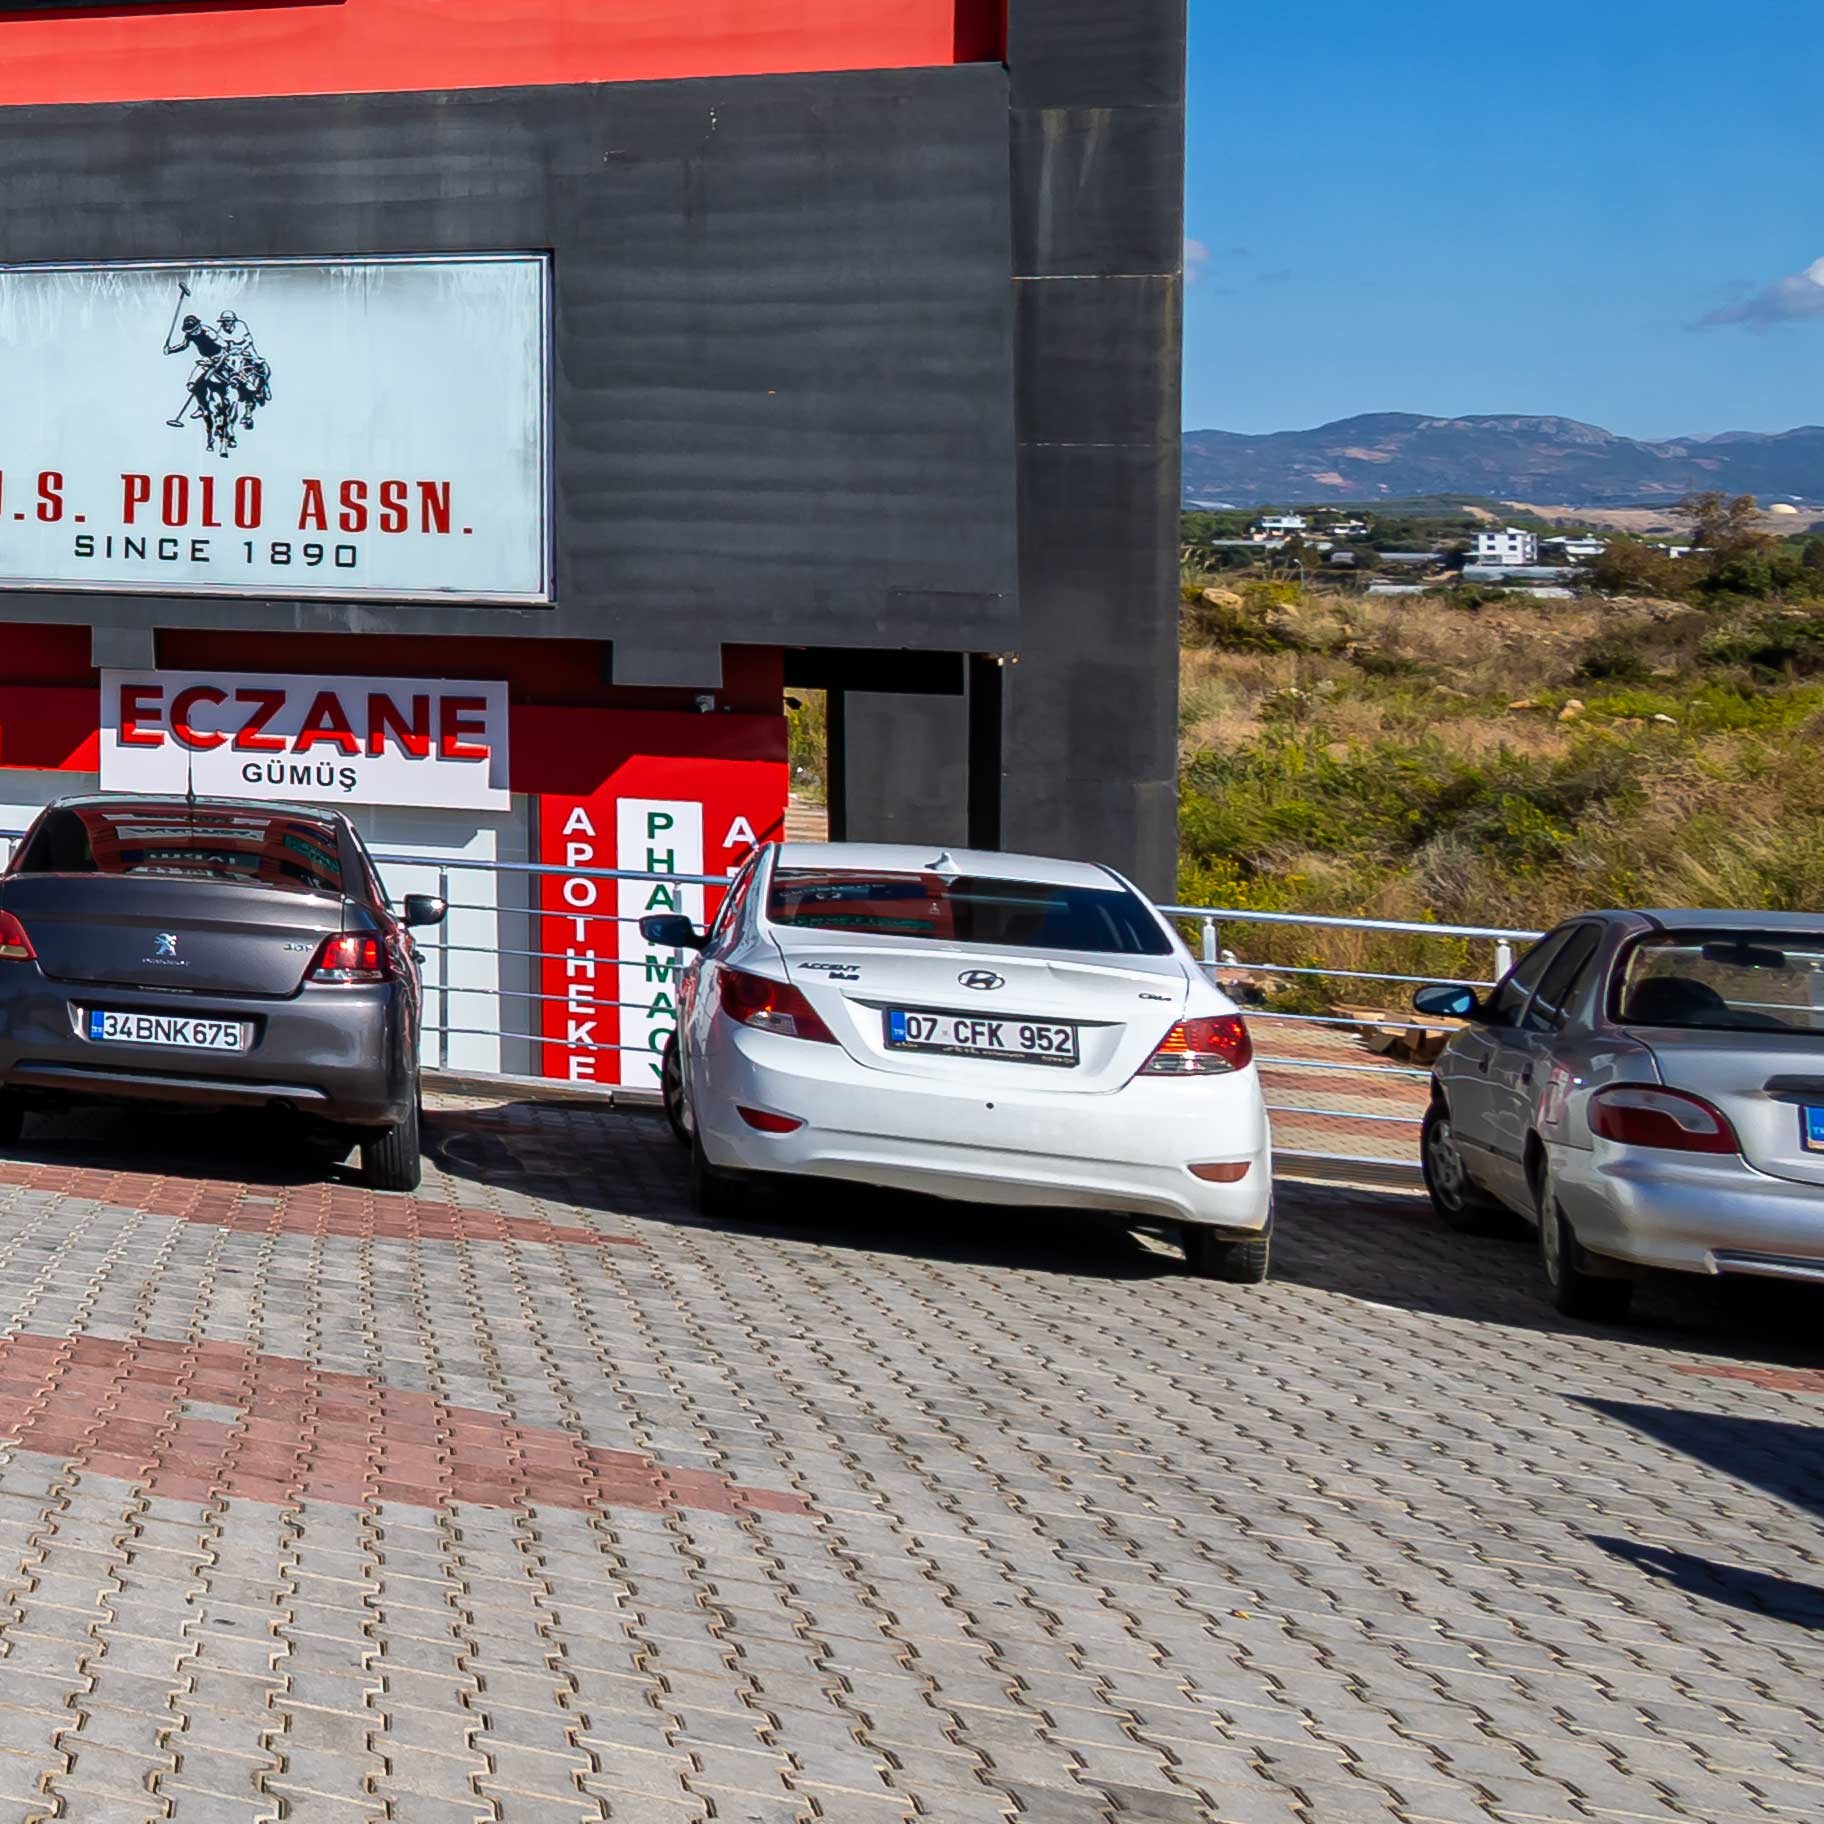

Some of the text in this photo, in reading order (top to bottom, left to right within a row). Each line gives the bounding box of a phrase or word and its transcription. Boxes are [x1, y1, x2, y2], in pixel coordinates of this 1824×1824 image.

[120, 473, 263, 529] POLO
[298, 478, 474, 536] ASSN.
[73, 533, 358, 569] SINCE 1890
[117, 685, 492, 761] ECZANE
[240, 760, 359, 793] GÜMÜŞ
[562, 806, 597, 1085] APOTHEKE
[905, 1015, 939, 1042] 07
[953, 1020, 1005, 1049] CFK
[1019, 1026, 1073, 1054] 952
